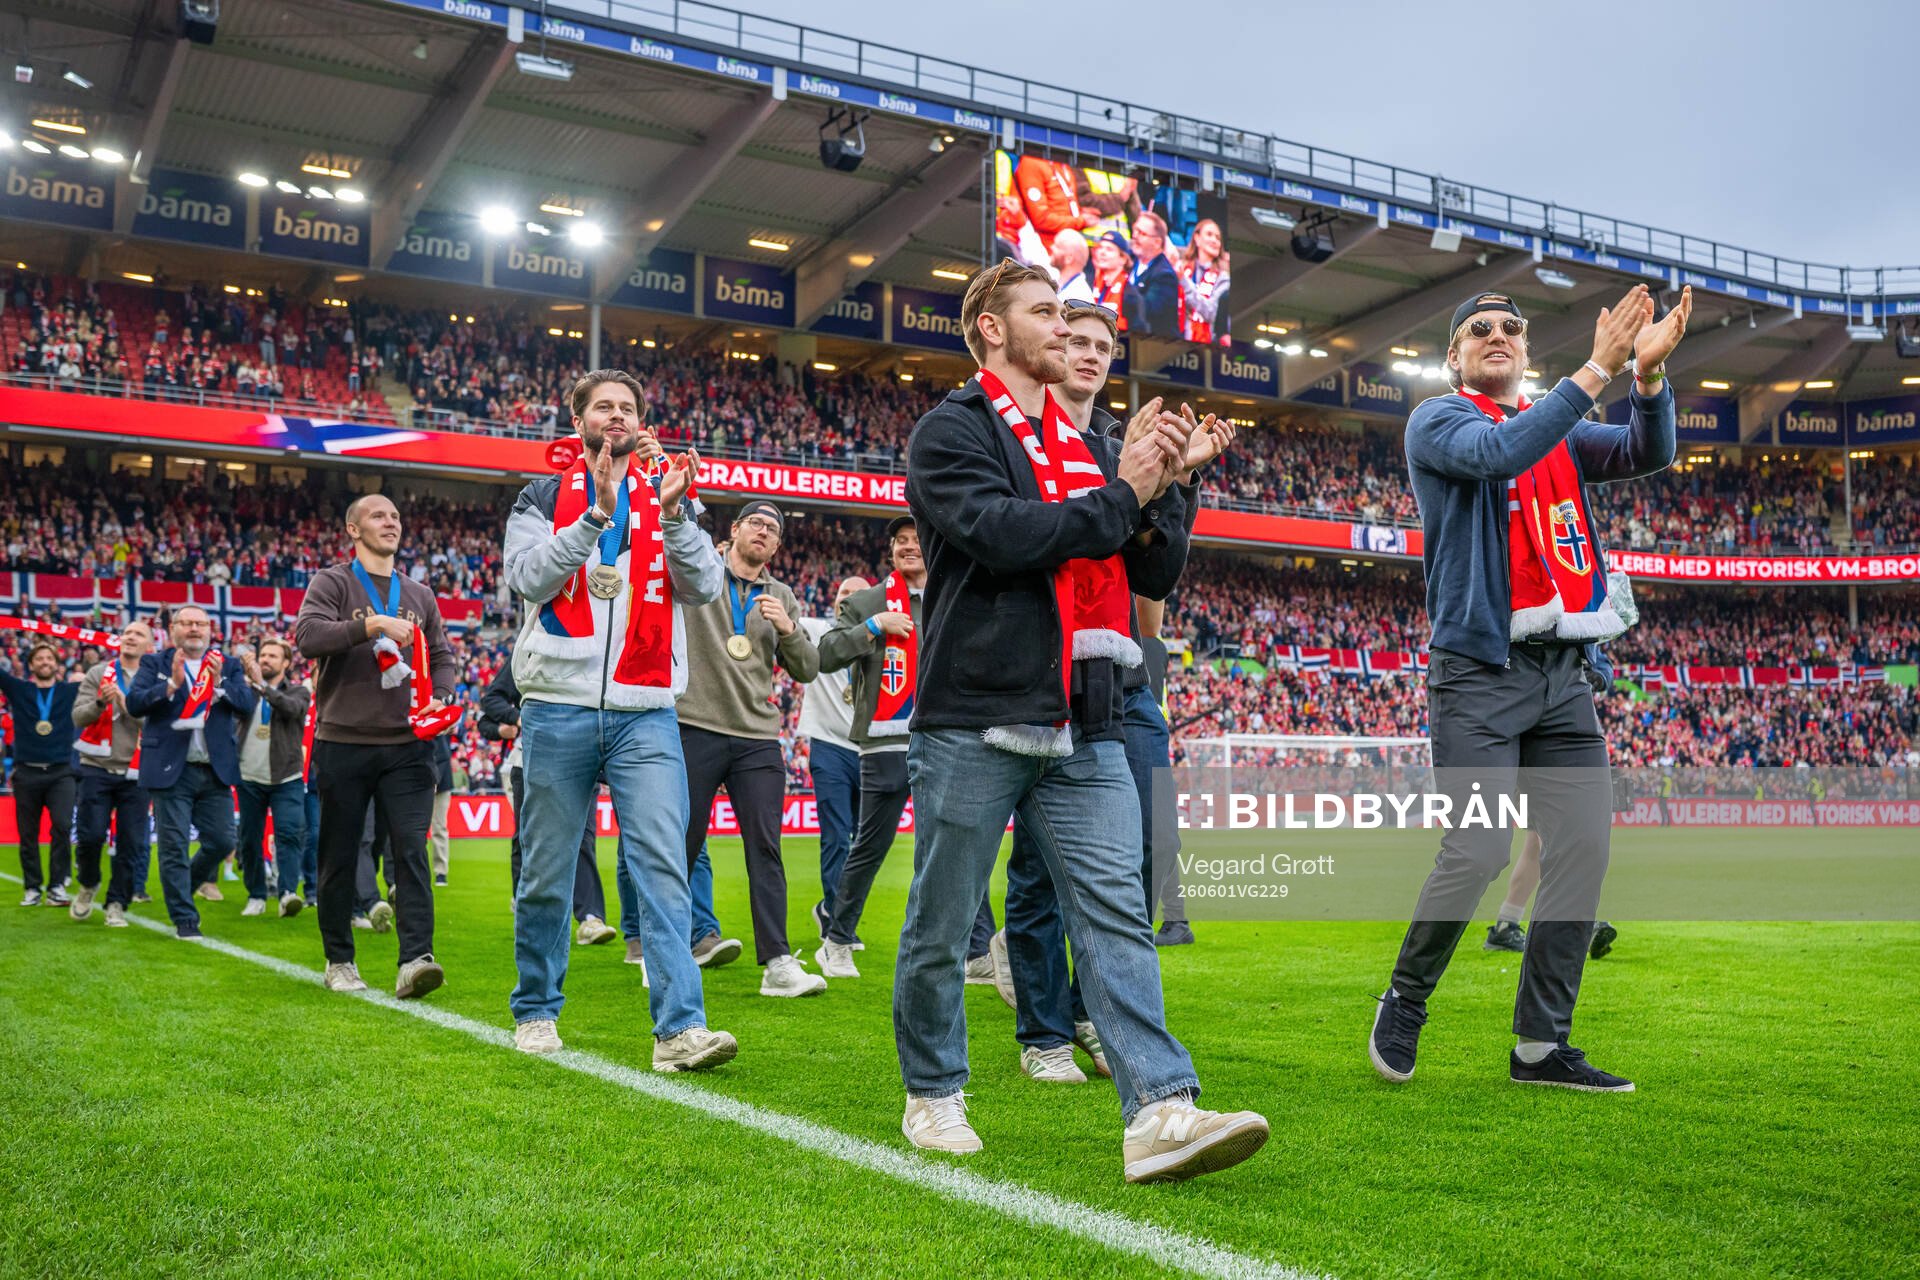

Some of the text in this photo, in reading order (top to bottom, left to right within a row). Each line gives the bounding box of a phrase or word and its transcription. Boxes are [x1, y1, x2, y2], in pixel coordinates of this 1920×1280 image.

[443, 0, 491, 20] bama
[630, 36, 674, 61] bama
[717, 56, 758, 80] bama
[800, 75, 840, 98] bama
[879, 92, 917, 114] bama
[954, 109, 991, 130] bama
[6, 166, 105, 208] bama
[1223, 169, 1254, 187] bama
[1283, 181, 1313, 200] bama
[273, 207, 360, 246] bama
[507, 243, 585, 279] bama
[629, 267, 687, 293] ama
[715, 275, 785, 310] bama
[1220, 353, 1271, 382] bama
[1357, 376, 1402, 402] bama
[1676, 412, 1718, 430] ama
[1785, 410, 1838, 433] bama
[1856, 410, 1916, 433] bama
[694, 461, 907, 502] GRATULERER ME
[1669, 558, 1711, 577] MED
[1715, 558, 1822, 578] HISTORISK
[1825, 557, 1920, 577] VM-BRO
[351, 605, 423, 627] GAERY
[458, 801, 500, 832] VI
[781, 801, 820, 829] ME
[1746, 803, 1785, 825] MED
